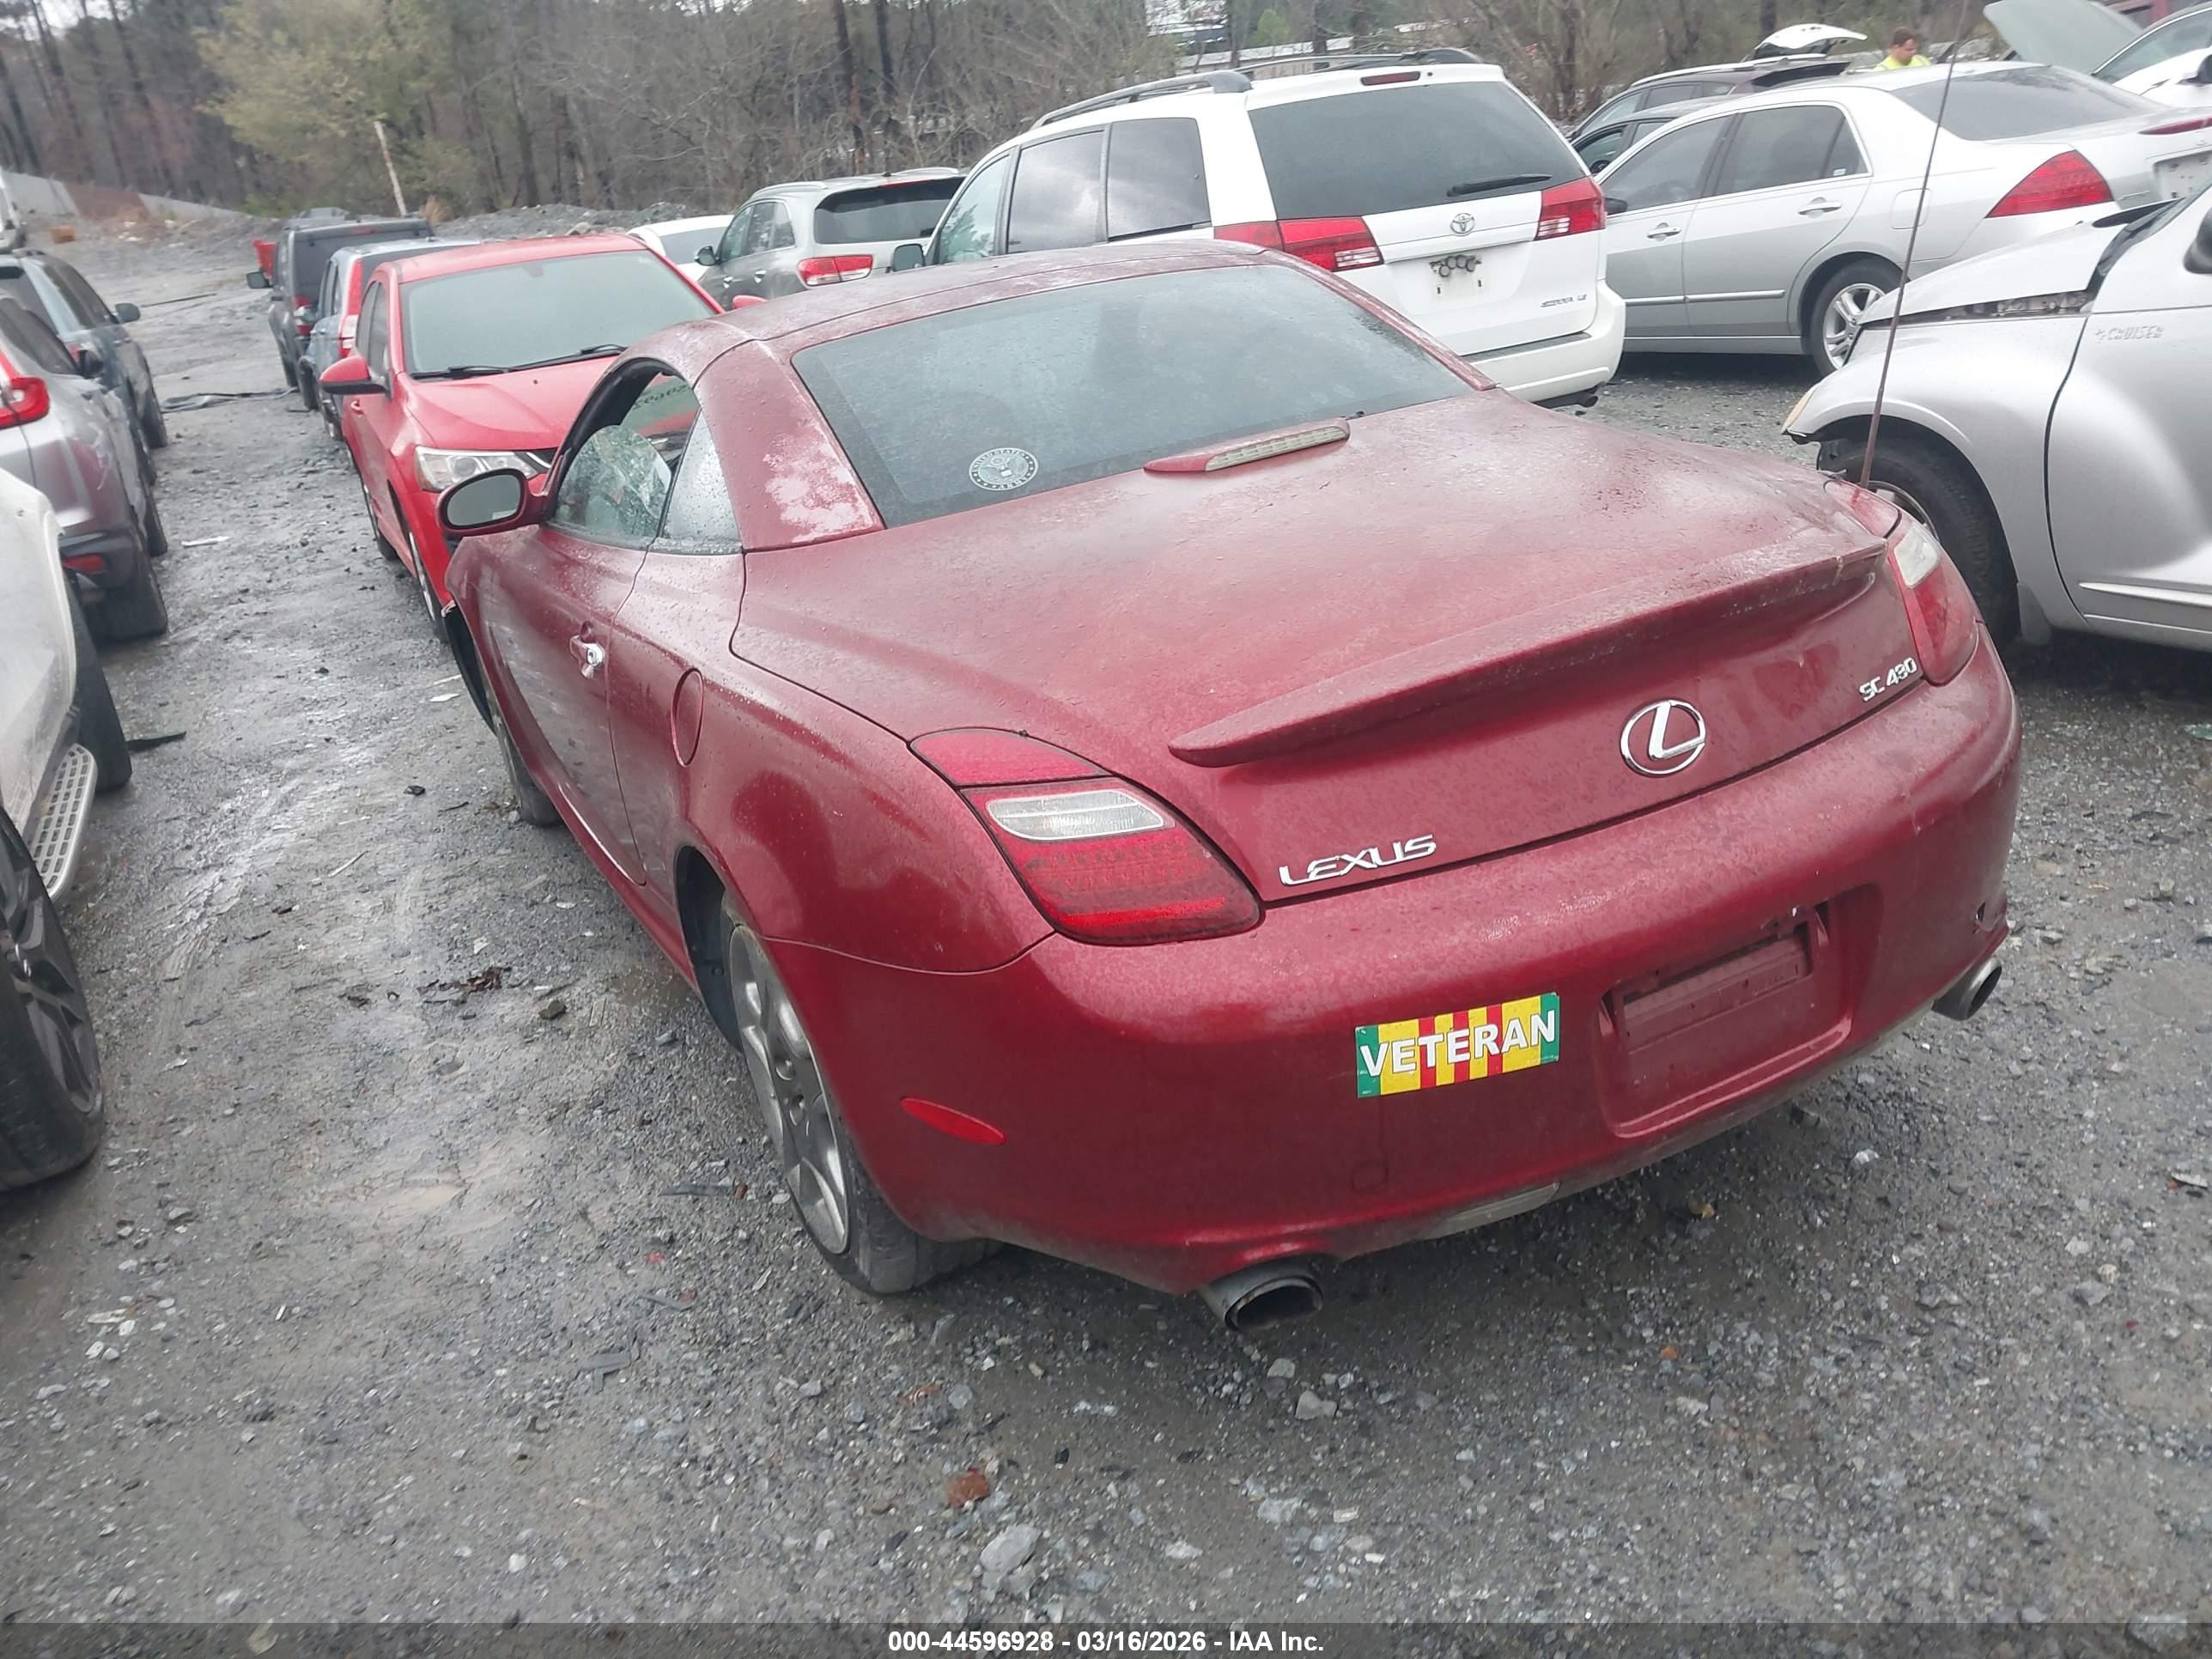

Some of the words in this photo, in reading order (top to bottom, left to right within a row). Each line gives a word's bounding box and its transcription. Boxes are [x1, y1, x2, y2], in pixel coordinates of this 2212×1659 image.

[1859, 676, 1885, 702] SC
[1886, 657, 1917, 686] 430
[1279, 833, 1437, 887] LEXUS
[1359, 1010, 1555, 1077] VETERAN
